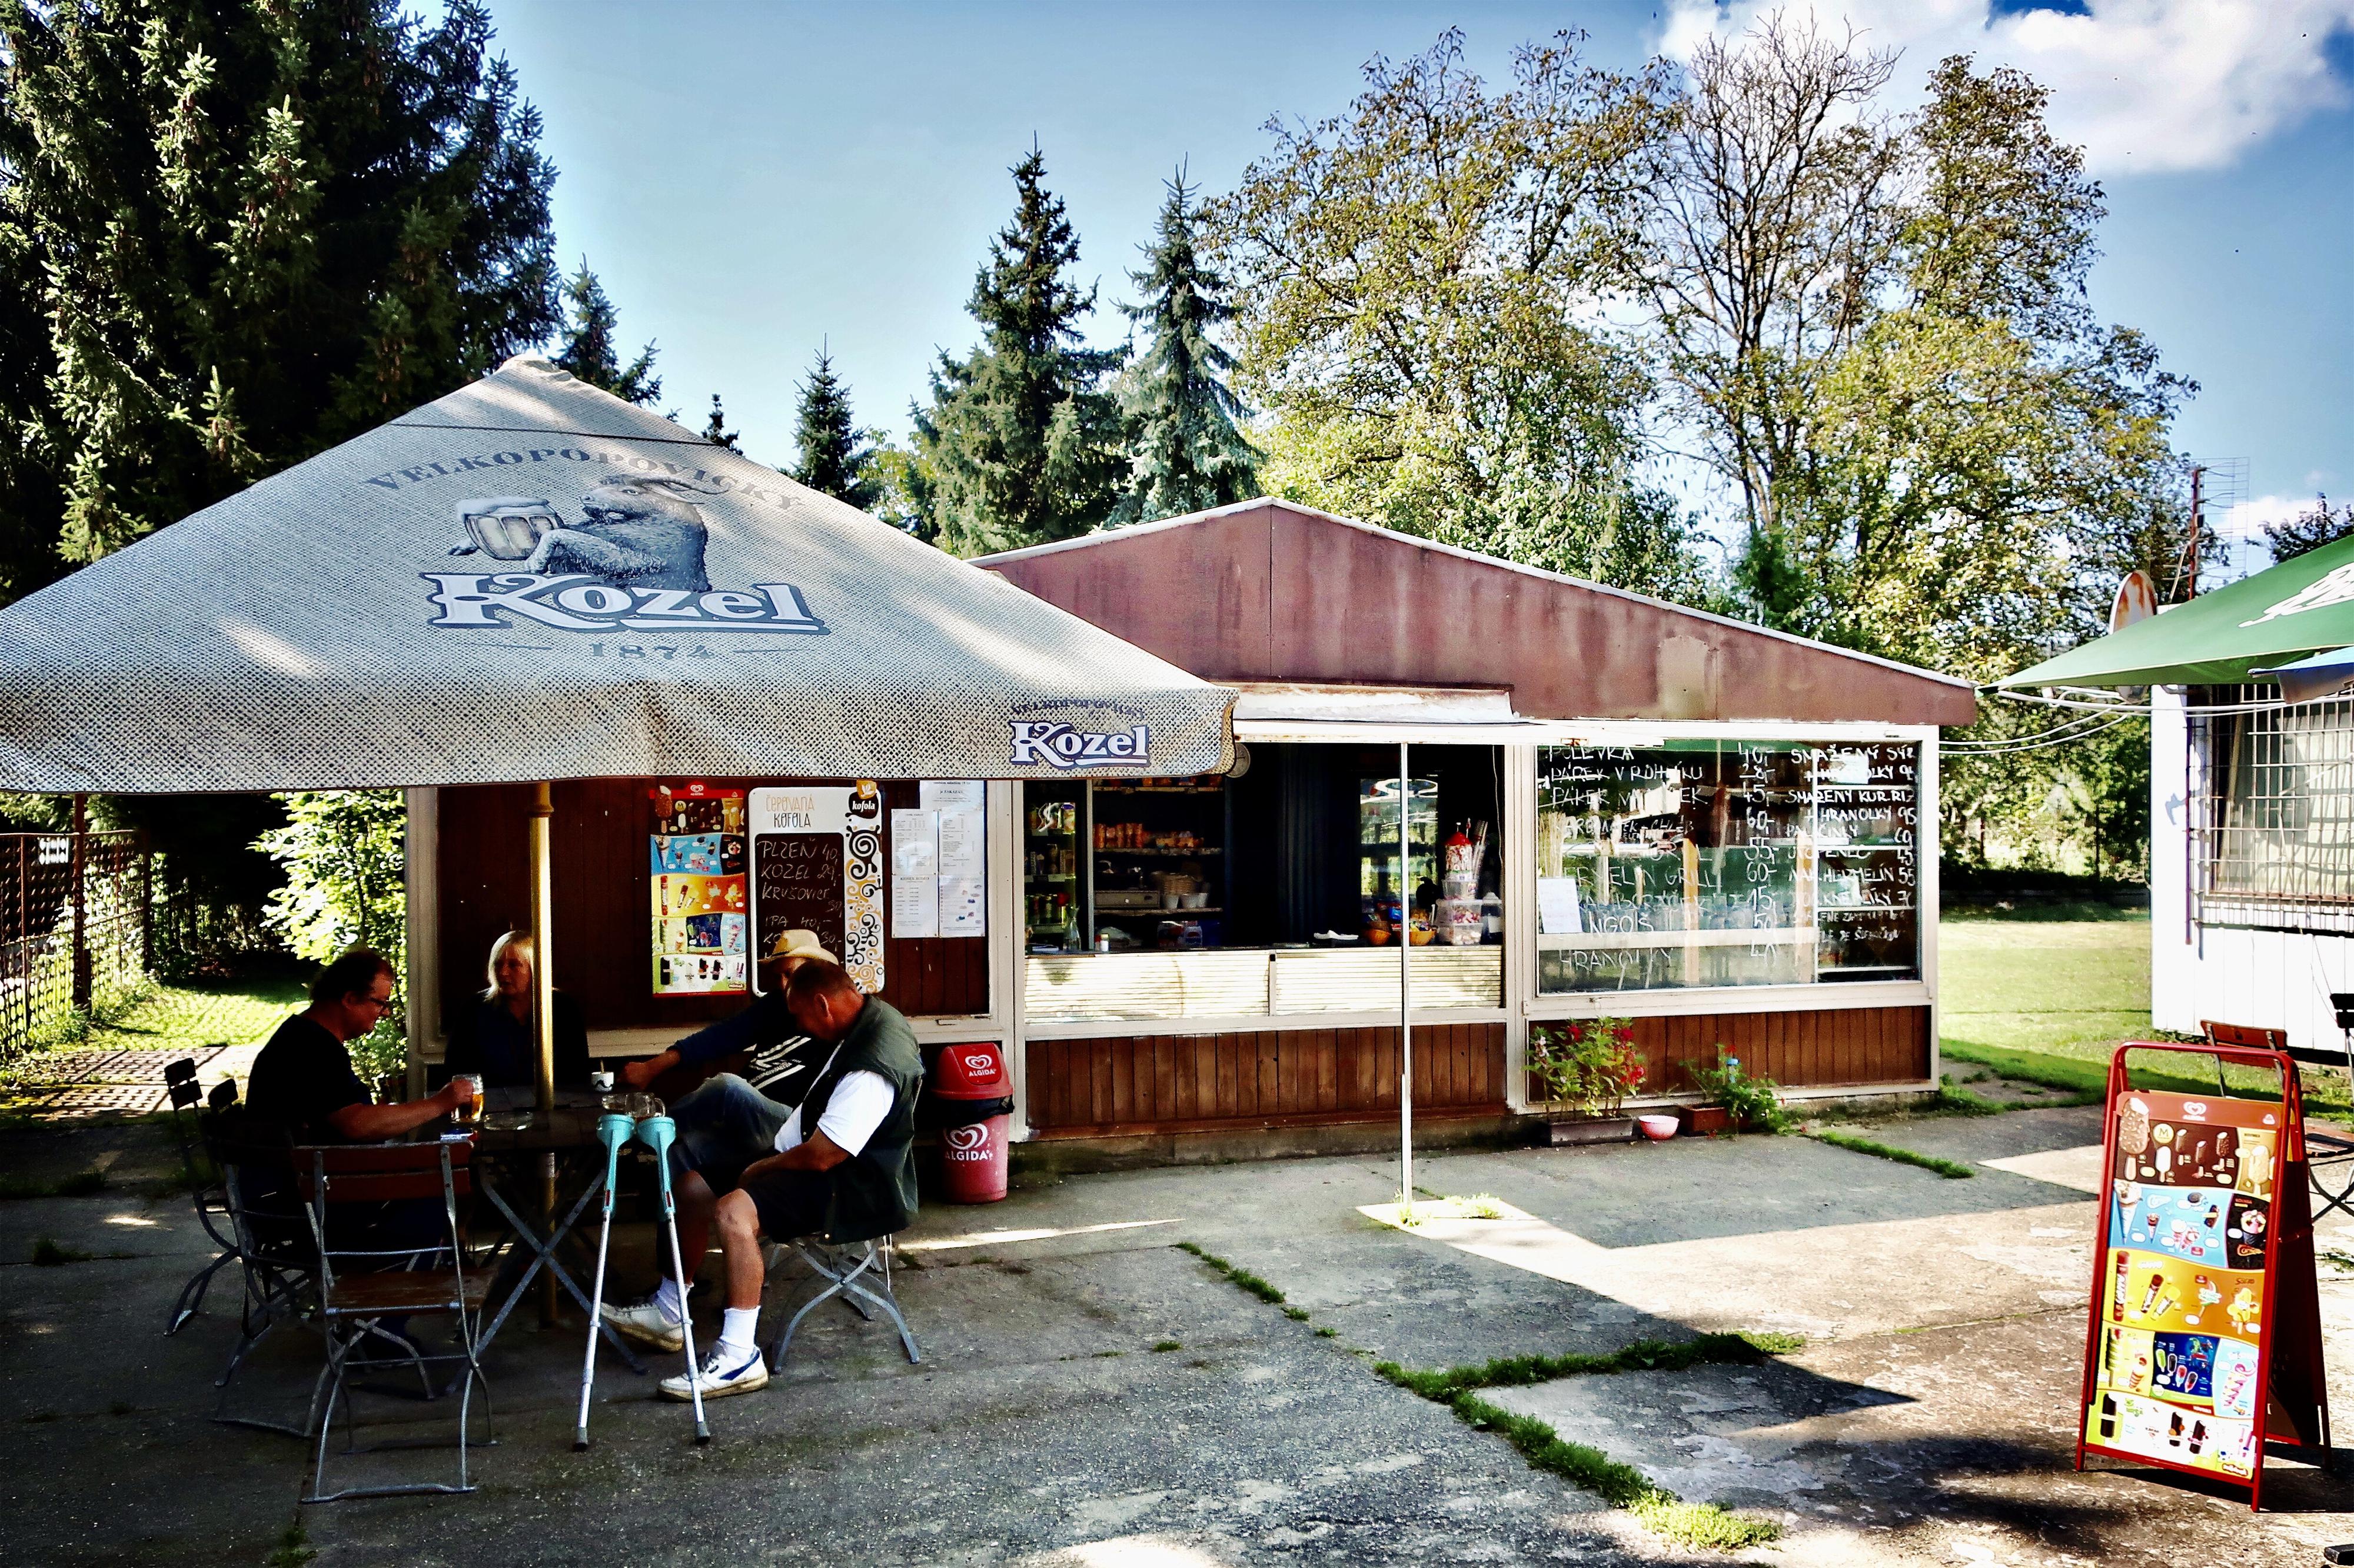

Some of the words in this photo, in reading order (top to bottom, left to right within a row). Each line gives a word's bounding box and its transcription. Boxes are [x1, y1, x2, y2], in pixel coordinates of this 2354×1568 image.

[420, 572, 830, 635] Kozel
[590, 642, 717, 661] 1874
[1008, 720, 1151, 770] Kozel
[1630, 761, 1703, 781] ROHÍKU
[852, 801, 876, 813] kofola
[774, 813, 812, 828] KOFOLA
[757, 837, 818, 859] PLZEŇ
[761, 862, 810, 880] KOZEL
[766, 915, 789, 927] IPA
[946, 1150, 989, 1161] ALGIDA
